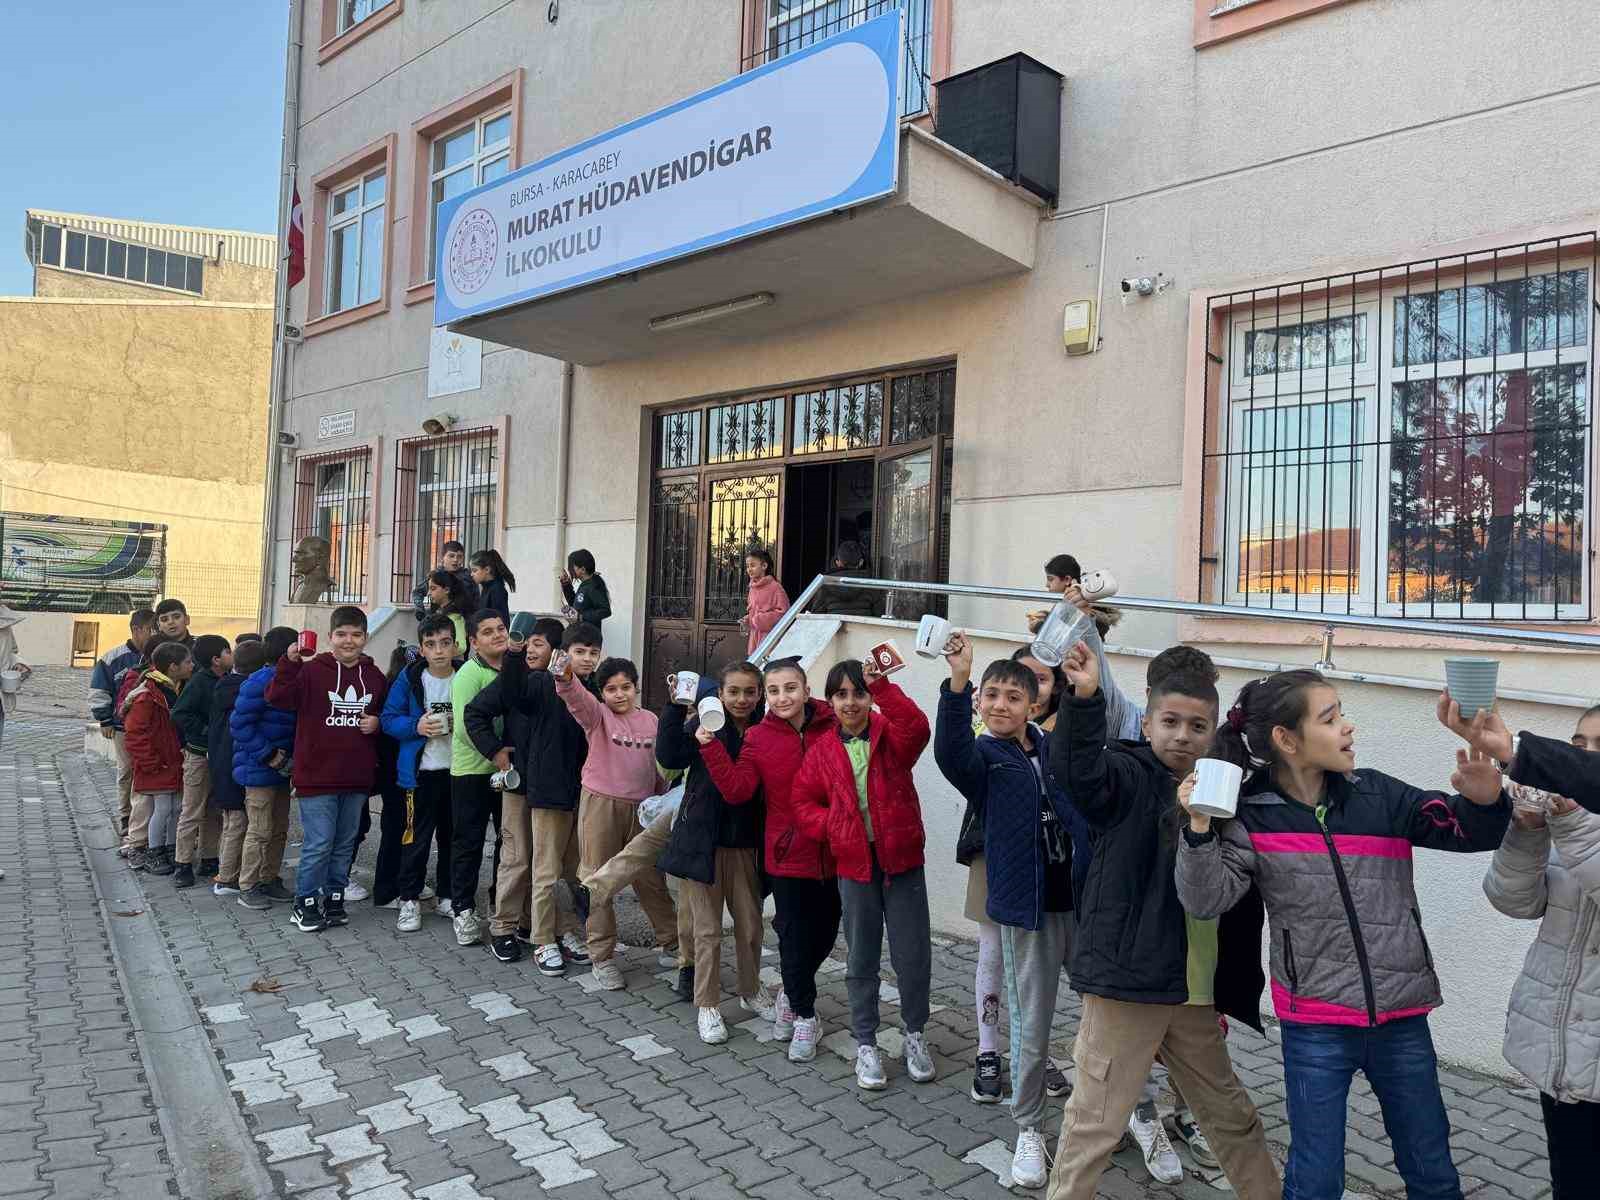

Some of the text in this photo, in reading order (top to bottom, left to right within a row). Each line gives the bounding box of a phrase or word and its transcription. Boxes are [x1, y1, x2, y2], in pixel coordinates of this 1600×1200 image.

[507, 125, 772, 243] MURAT HÜDAVENDİGAR
[511, 183, 544, 208] BURSA
[553, 150, 621, 192] KARACABEY
[506, 226, 602, 278] İLKOKULU
[325, 714, 361, 727] adid
